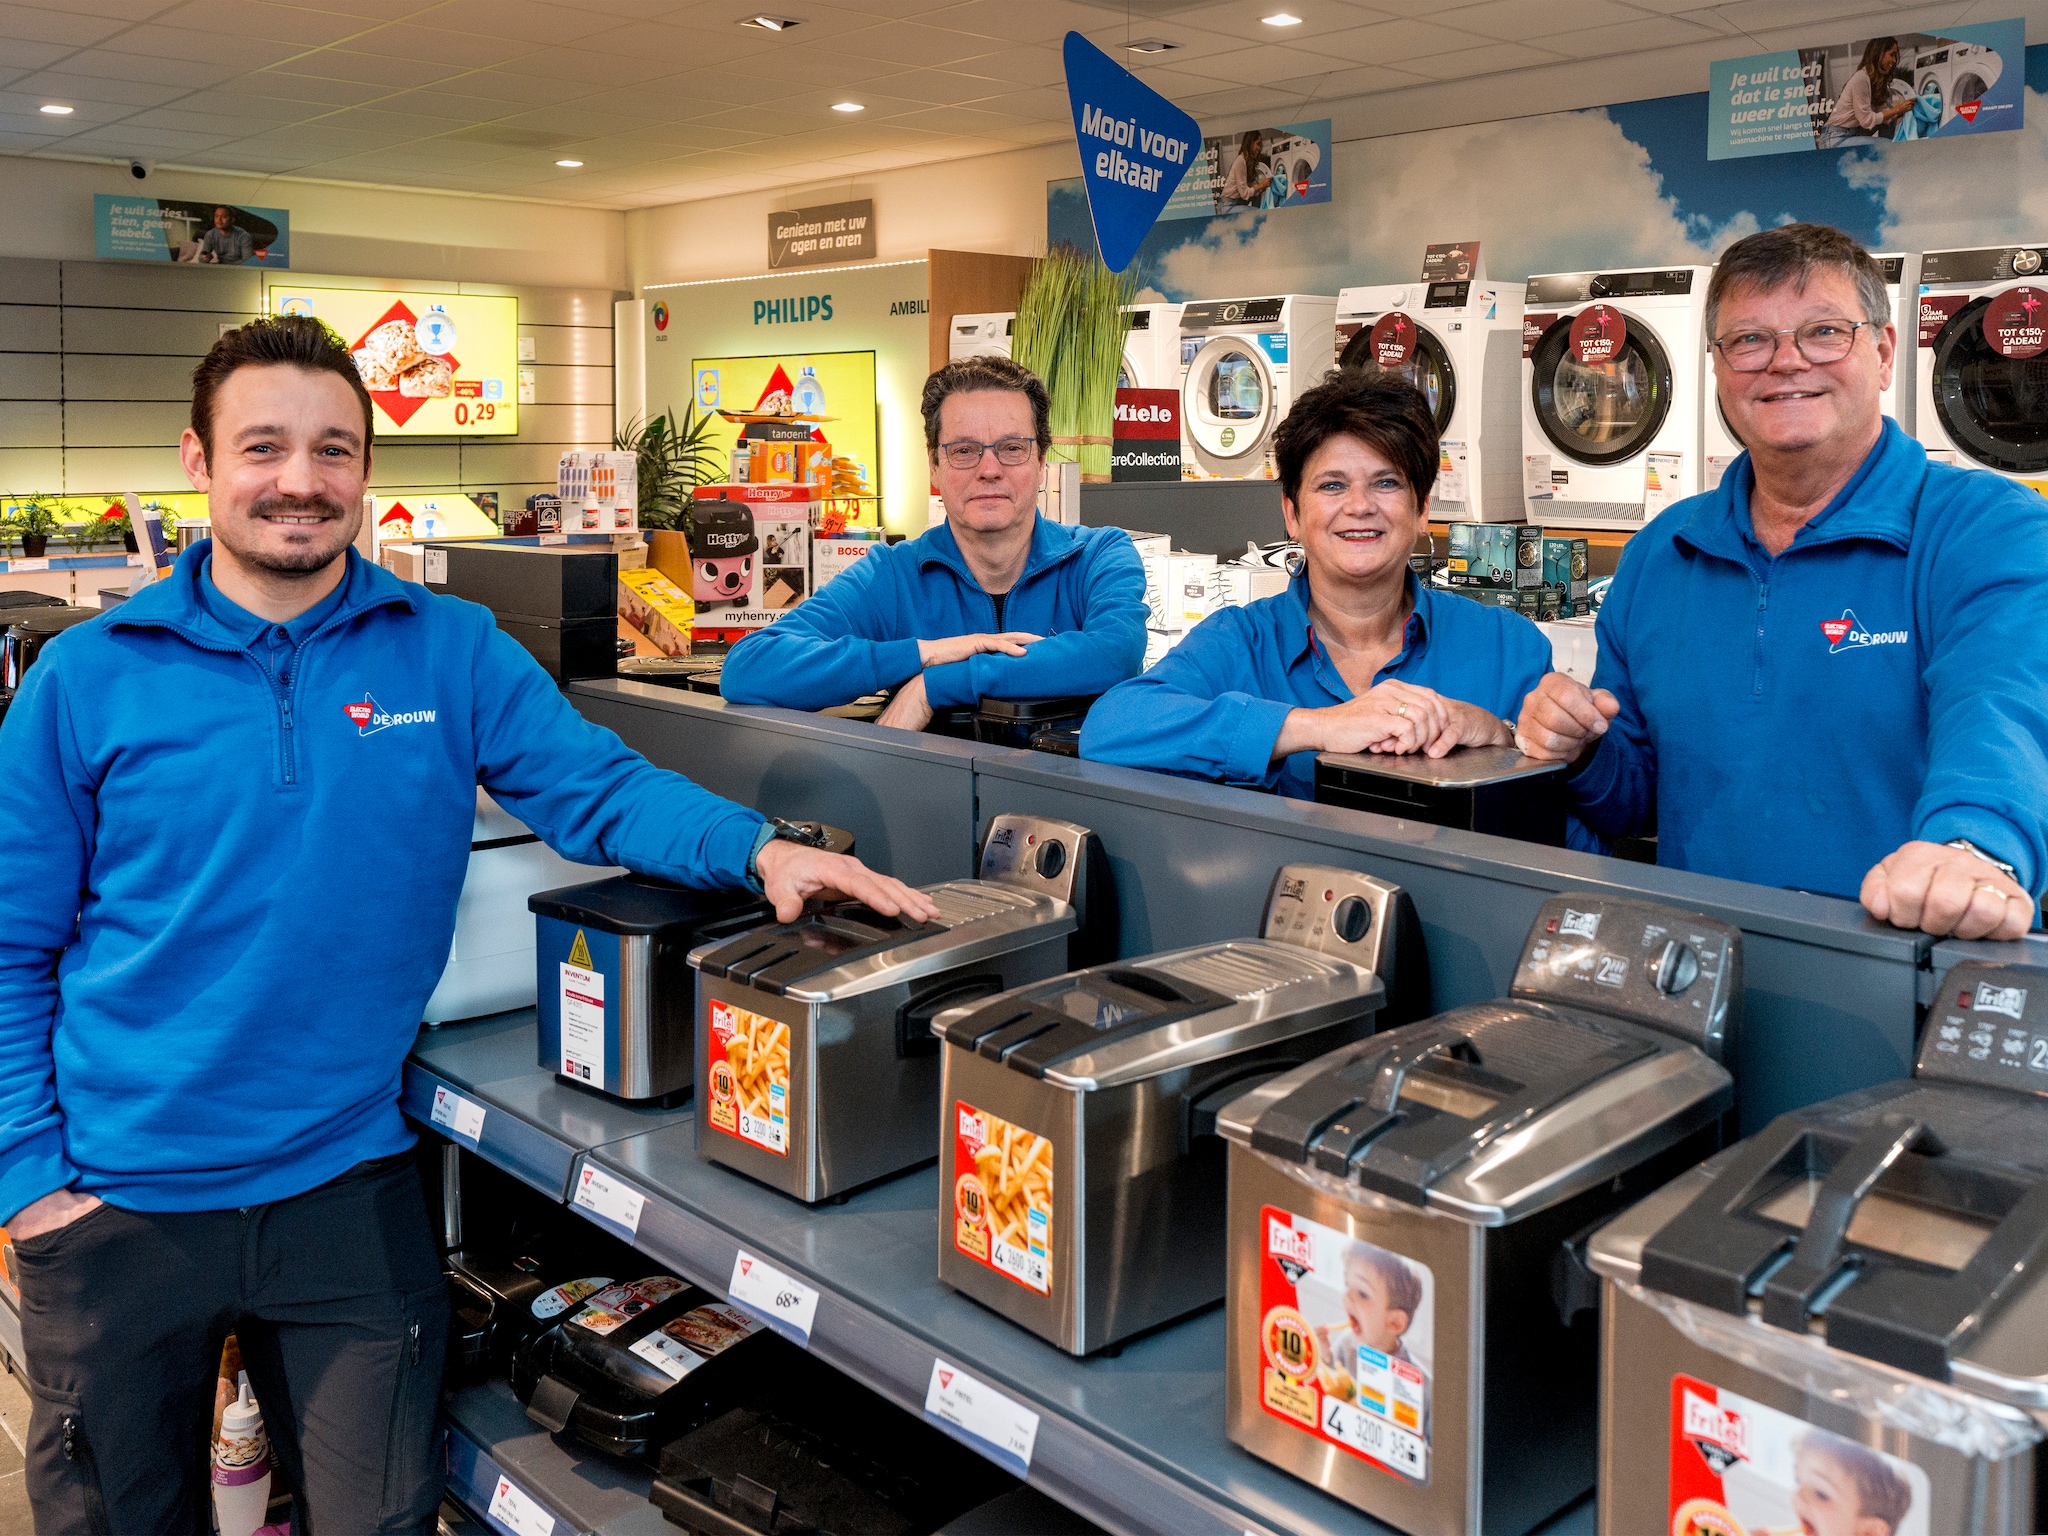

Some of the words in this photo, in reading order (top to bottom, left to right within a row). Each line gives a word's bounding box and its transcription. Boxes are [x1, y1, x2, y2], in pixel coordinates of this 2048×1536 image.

[1730, 73, 1747, 91] Je
[1750, 66, 1779, 85] wil
[1782, 61, 1822, 81] toch
[1731, 89, 1761, 106] dat
[1764, 86, 1780, 101] ie
[1783, 79, 1821, 99] snel
[1730, 108, 1775, 124] weer
[1778, 98, 1836, 119] draait.
[1081, 103, 1136, 148] Mooi
[1140, 128, 1188, 165] voor
[1742, 126, 1766, 135] komen
[1784, 122, 1802, 131] langs
[1816, 119, 1824, 128] je
[1730, 135, 1773, 145] wasmachine
[1096, 149, 1163, 193] elkaar
[1195, 161, 1218, 176] snel
[1192, 175, 1227, 190] draait.
[124, 206, 145, 216] wil
[146, 207, 182, 218] series
[142, 220, 172, 230] geen
[777, 222, 822, 239] Genieten
[824, 218, 846, 233] met
[848, 216, 867, 230] uw
[790, 239, 817, 255] ogen
[819, 236, 833, 250] en
[835, 233, 862, 248] oren
[754, 295, 833, 325] PHILIPS
[890, 300, 929, 316] AMBILI
[2003, 337, 2042, 345] CADEAU
[455, 403, 495, 425] 0.29
[1114, 404, 1172, 422] Miele
[1111, 452, 1180, 466] areCollection
[748, 489, 782, 499] Henry
[708, 533, 740, 546] Hetty
[1849, 631, 1869, 644] DE
[1872, 631, 1908, 645] ROUW
[373, 714, 390, 725] DE
[394, 710, 436, 725] ROUW
[1283, 880, 1304, 895] Fritel
[565, 969, 590, 983] INVENTUM
[1597, 957, 1612, 981] 2
[715, 1011, 734, 1031] Fritel
[718, 1075, 728, 1089] 10
[742, 1116, 750, 1134] 3
[754, 1120, 766, 1136] 2200
[961, 1116, 985, 1142] Fritel
[966, 1190, 978, 1208] 10
[994, 1242, 1003, 1263] 4
[1273, 1227, 1313, 1263] Fritel
[725, 1308, 752, 1326] Tefal
[1281, 1329, 1301, 1350] 10
[1327, 1405, 1344, 1435] 4
[1356, 1415, 1382, 1447] 3200
[1690, 1402, 1746, 1446] Fritel
